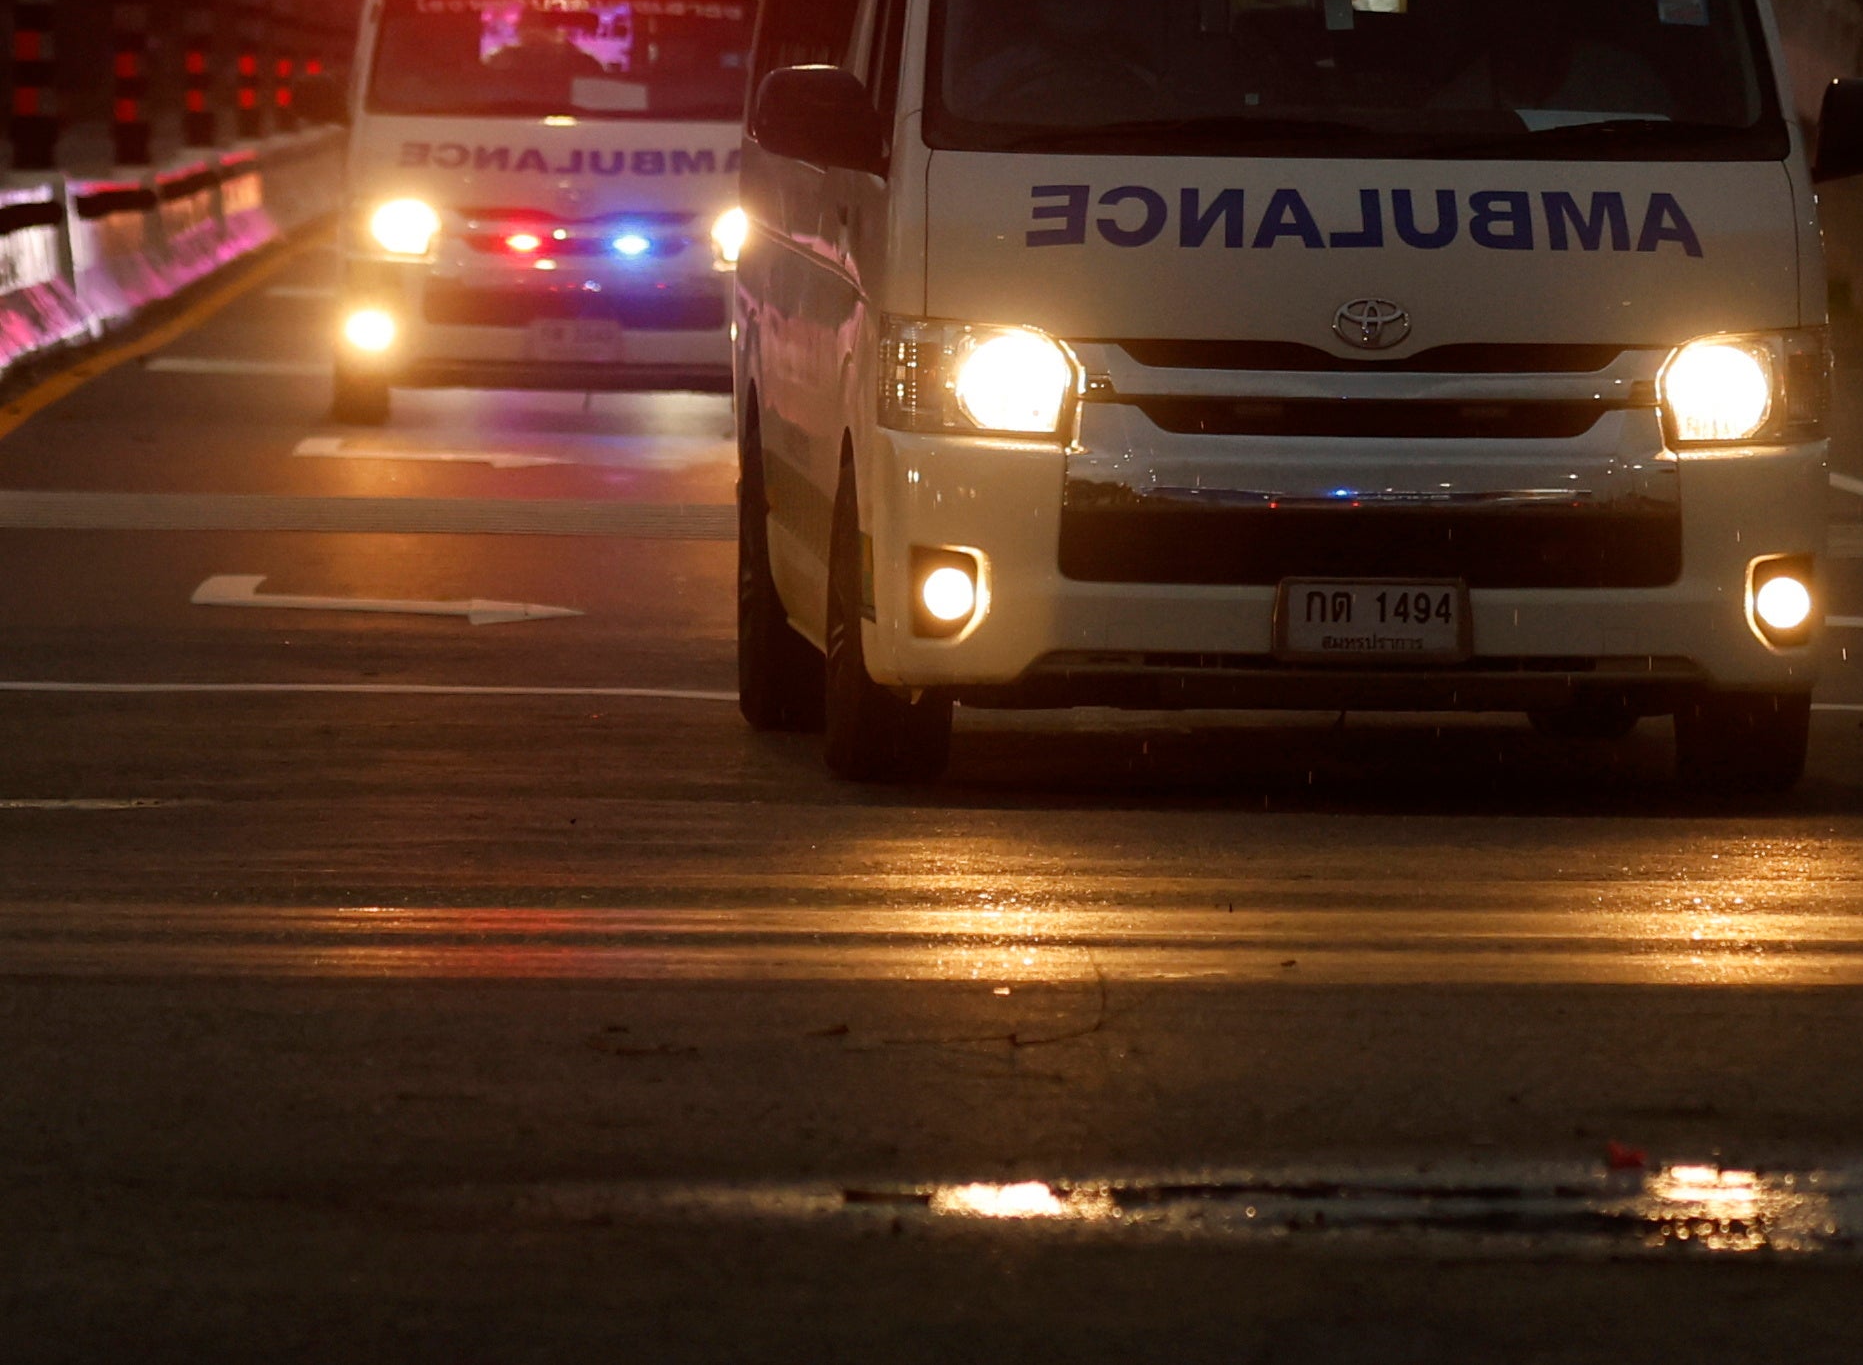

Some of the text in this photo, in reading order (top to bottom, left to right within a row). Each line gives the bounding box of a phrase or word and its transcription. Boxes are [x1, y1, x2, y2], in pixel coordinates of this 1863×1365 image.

[1376, 592, 1452, 624] 1494
[1321, 633, 1424, 650] สมทรปราการ
